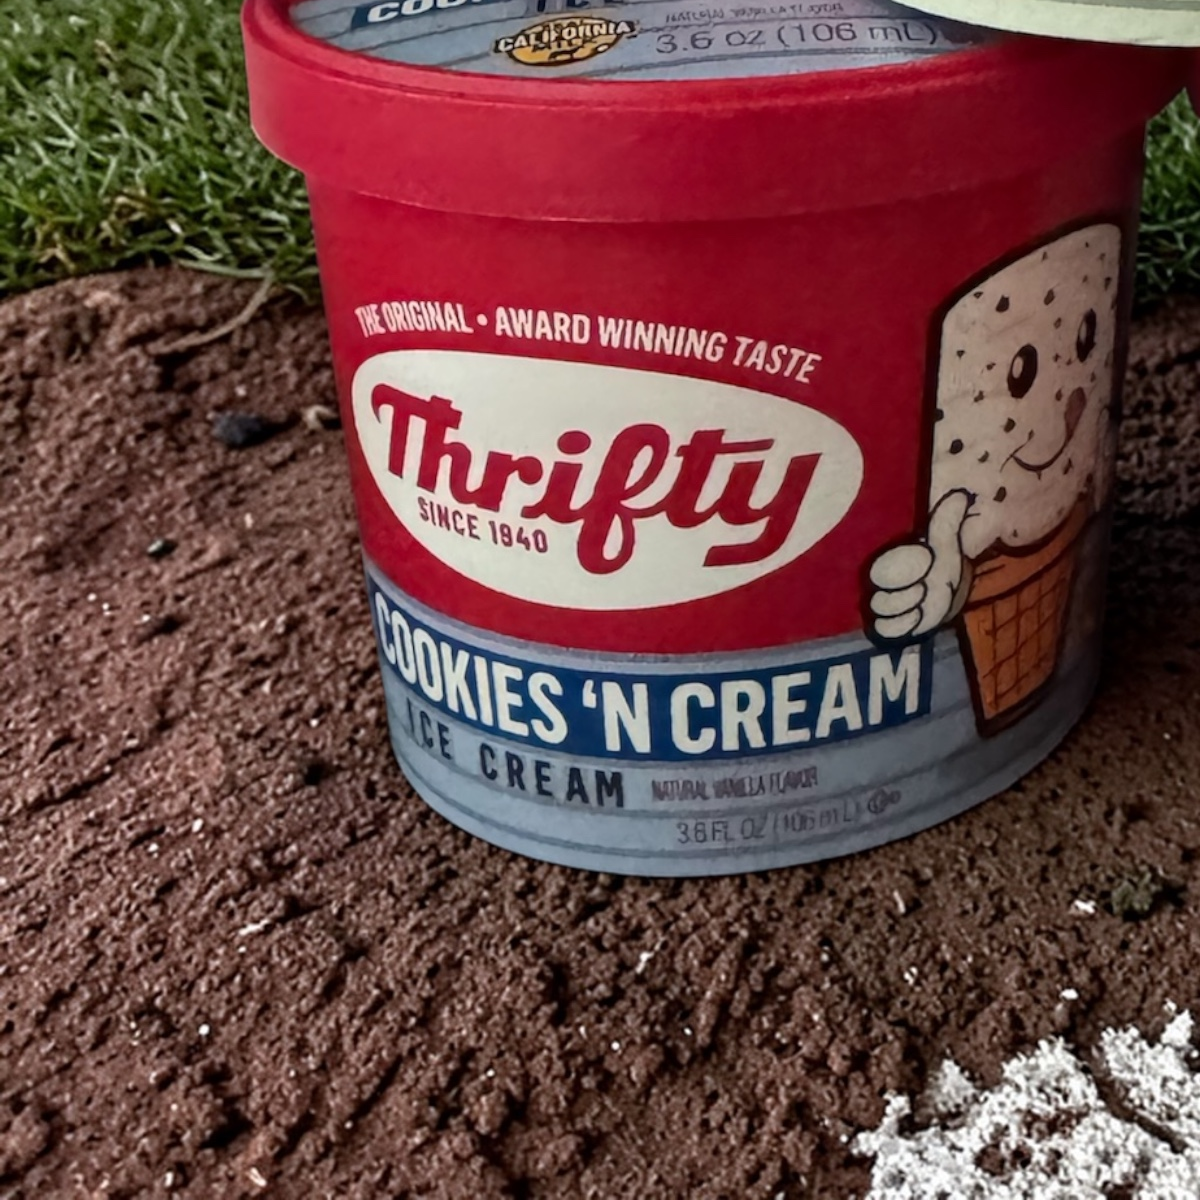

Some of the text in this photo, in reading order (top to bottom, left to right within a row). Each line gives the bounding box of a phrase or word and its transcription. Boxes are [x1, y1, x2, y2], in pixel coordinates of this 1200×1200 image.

[656, 33, 713, 54] 3.6
[778, 21, 857, 47] (106
[867, 21, 938, 47] mL)
[354, 300, 822, 384] THE ORIGINAL AWARD WINNING TASTE
[371, 383, 823, 575] Thrifty
[417, 496, 548, 553] SINCE 1940
[375, 591, 568, 744] COOKIES
[670, 645, 919, 754] CREAM
[406, 697, 454, 760] ICE
[479, 743, 624, 808] CREAM
